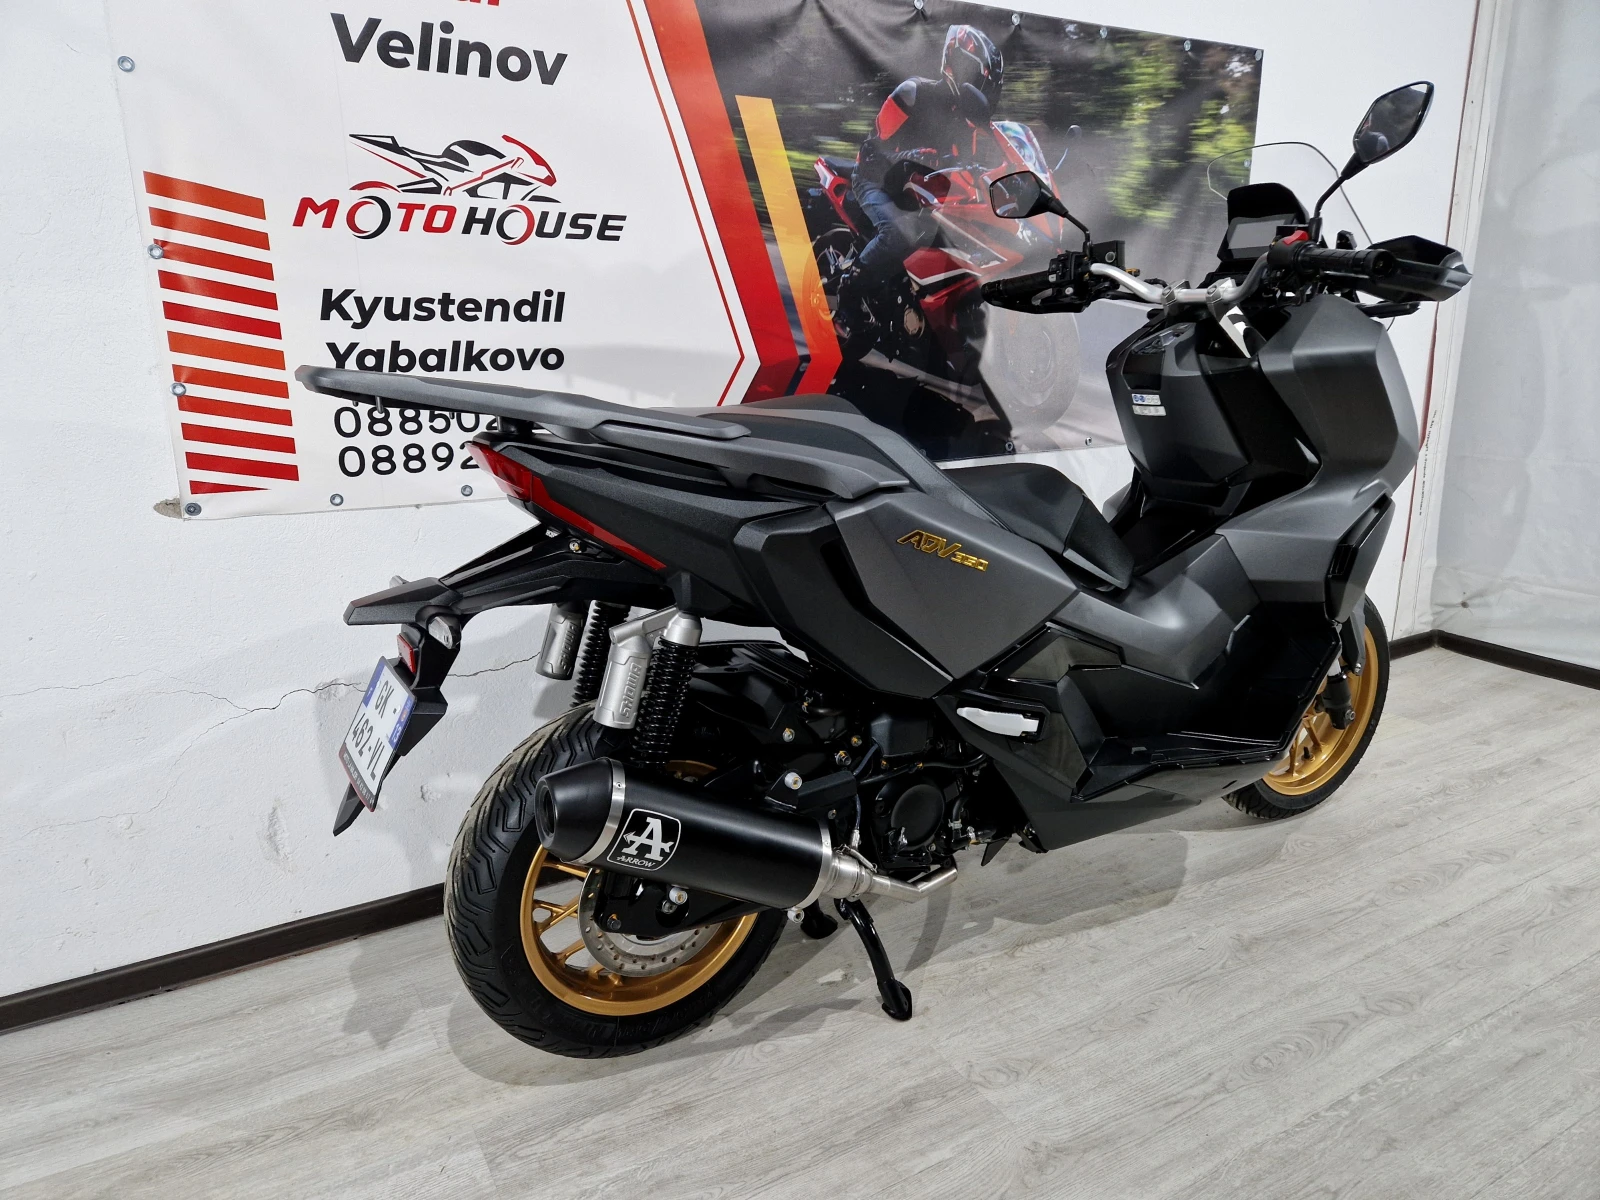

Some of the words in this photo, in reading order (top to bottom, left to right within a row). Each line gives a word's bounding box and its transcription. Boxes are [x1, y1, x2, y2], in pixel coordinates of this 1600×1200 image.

[330, 12, 568, 85] Velinov
[319, 289, 566, 329] Kyustendil
[326, 341, 565, 373] Yabalkovo
[897, 529, 962, 558] ADV
[619, 662, 642, 718] SHOWA
[352, 712, 386, 782] 462-VL
[616, 854, 656, 868] ARROW
